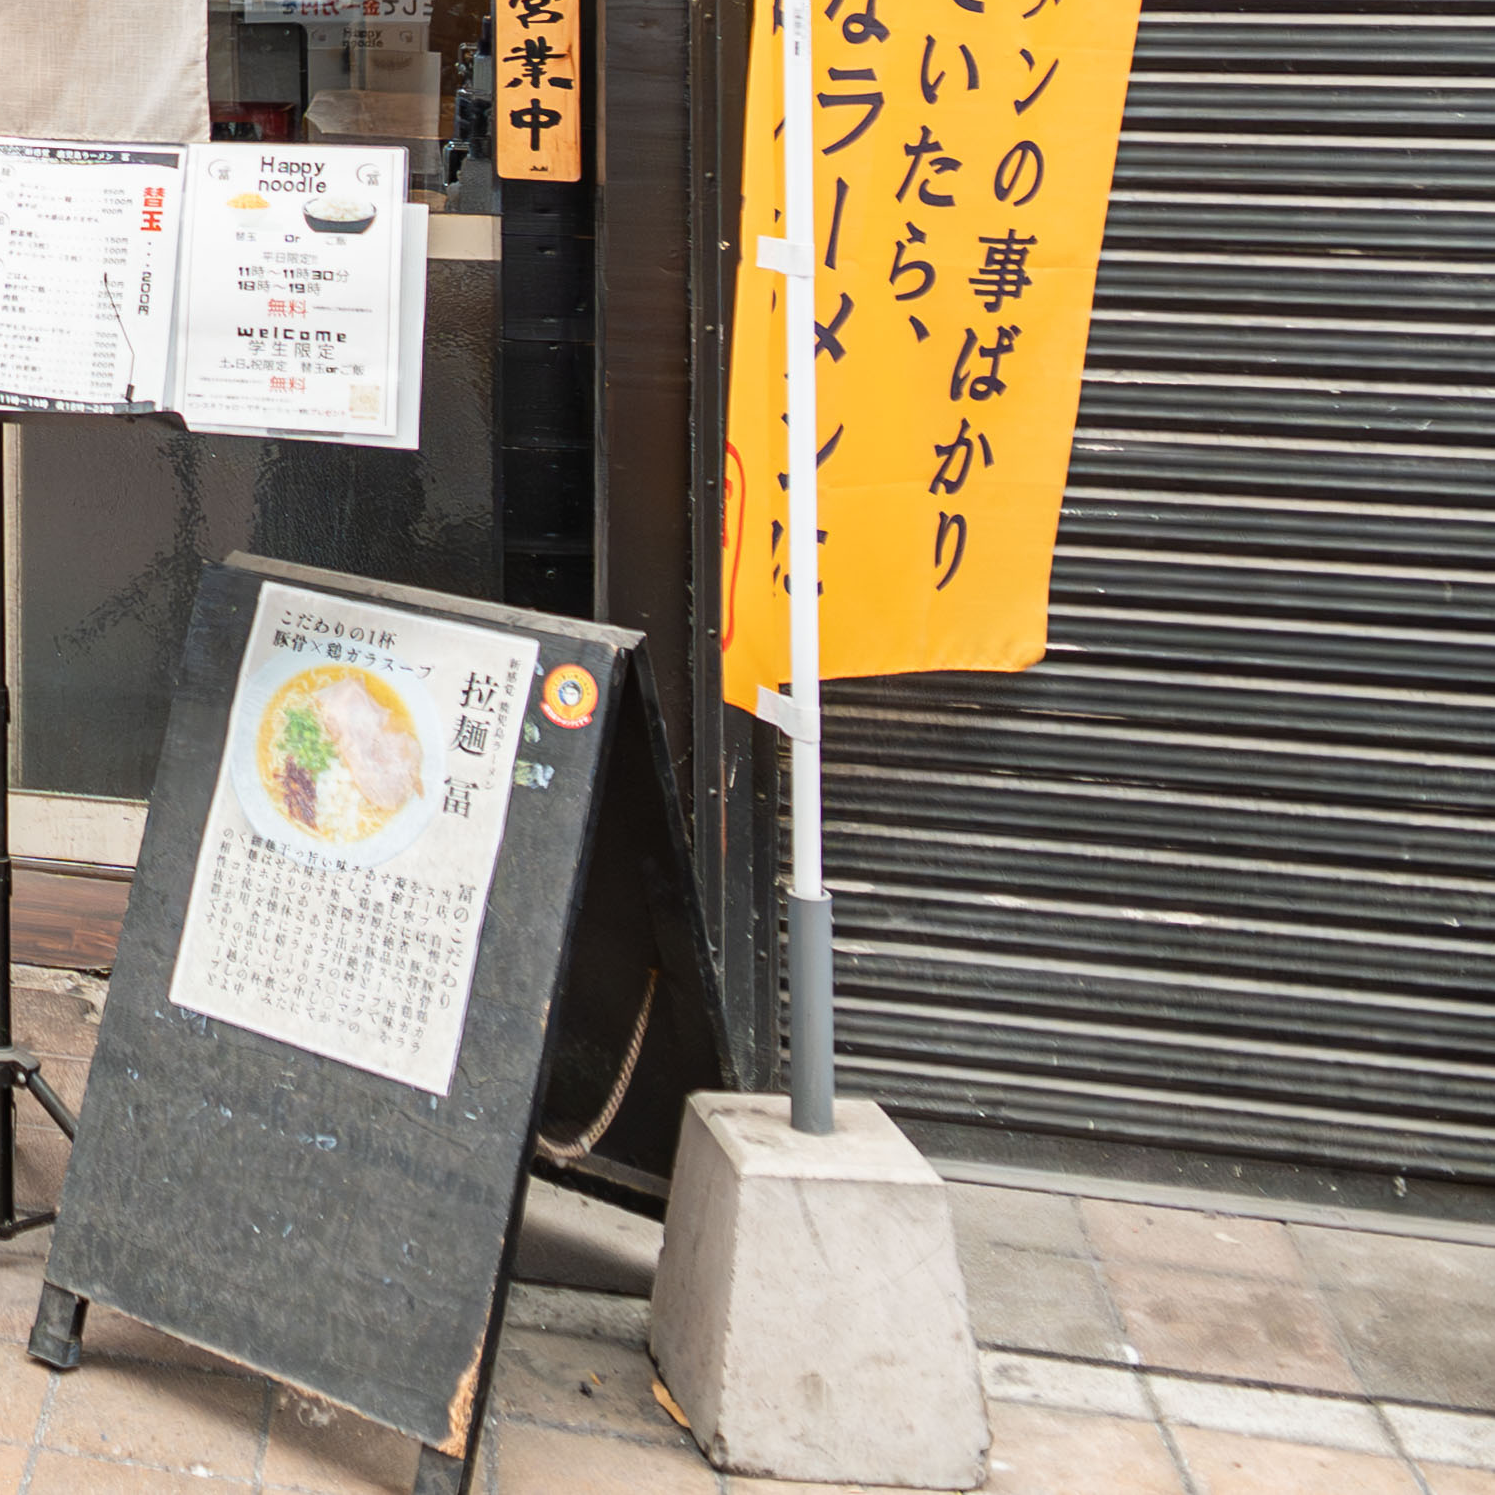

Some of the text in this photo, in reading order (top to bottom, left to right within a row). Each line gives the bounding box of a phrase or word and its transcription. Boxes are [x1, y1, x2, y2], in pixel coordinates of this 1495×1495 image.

[261, 156, 325, 178] Happy
[258, 177, 327, 193] noodle
[138, 187, 165, 316] 替玉 200円
[267, 298, 307, 318] 無料
[237, 326, 347, 343] welcome
[249, 340, 335, 361] 学生限定
[269, 375, 307, 394] 無料
[281, 610, 398, 649] こだわりの1杯
[273, 629, 436, 679] 豚骨×鶏ガラスープ
[448, 672, 499, 756] 拉麺
